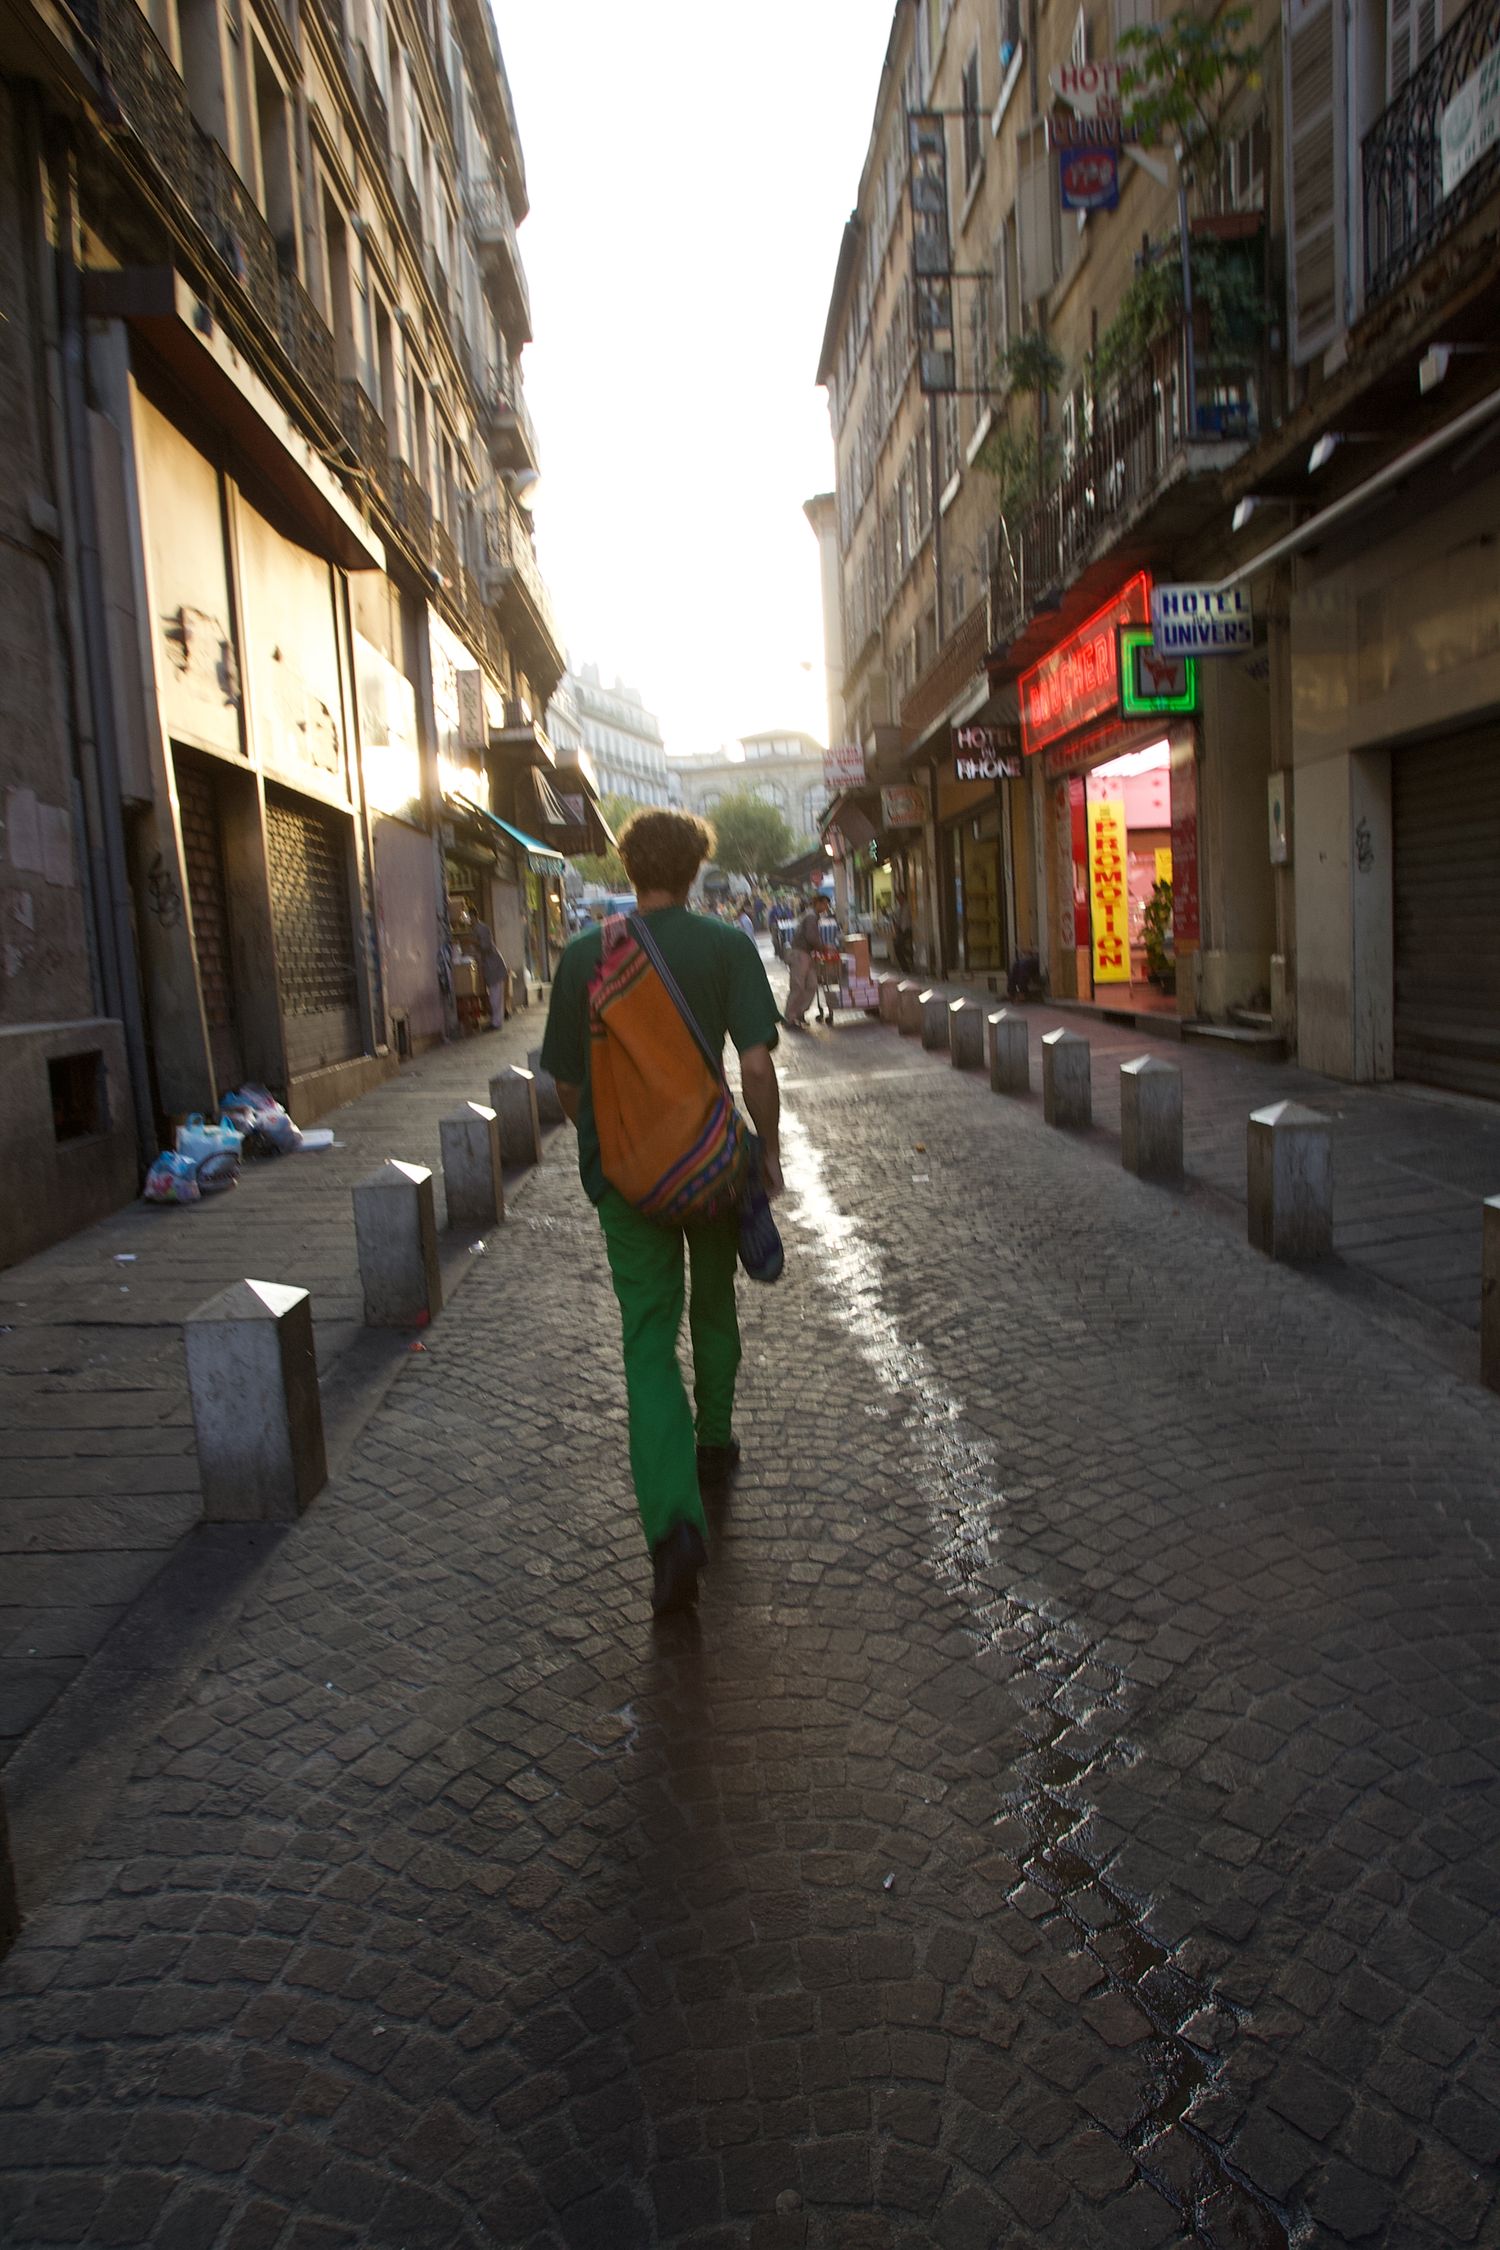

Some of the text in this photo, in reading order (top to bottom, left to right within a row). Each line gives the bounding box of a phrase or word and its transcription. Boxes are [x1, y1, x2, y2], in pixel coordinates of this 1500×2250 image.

[1162, 590, 1250, 615] HOTEL
[1163, 622, 1252, 646] UNIVERS
[1029, 625, 1118, 728] BOUCHERI
[957, 727, 1017, 748] HOTEL
[1094, 820, 1123, 969] PROMOTION
